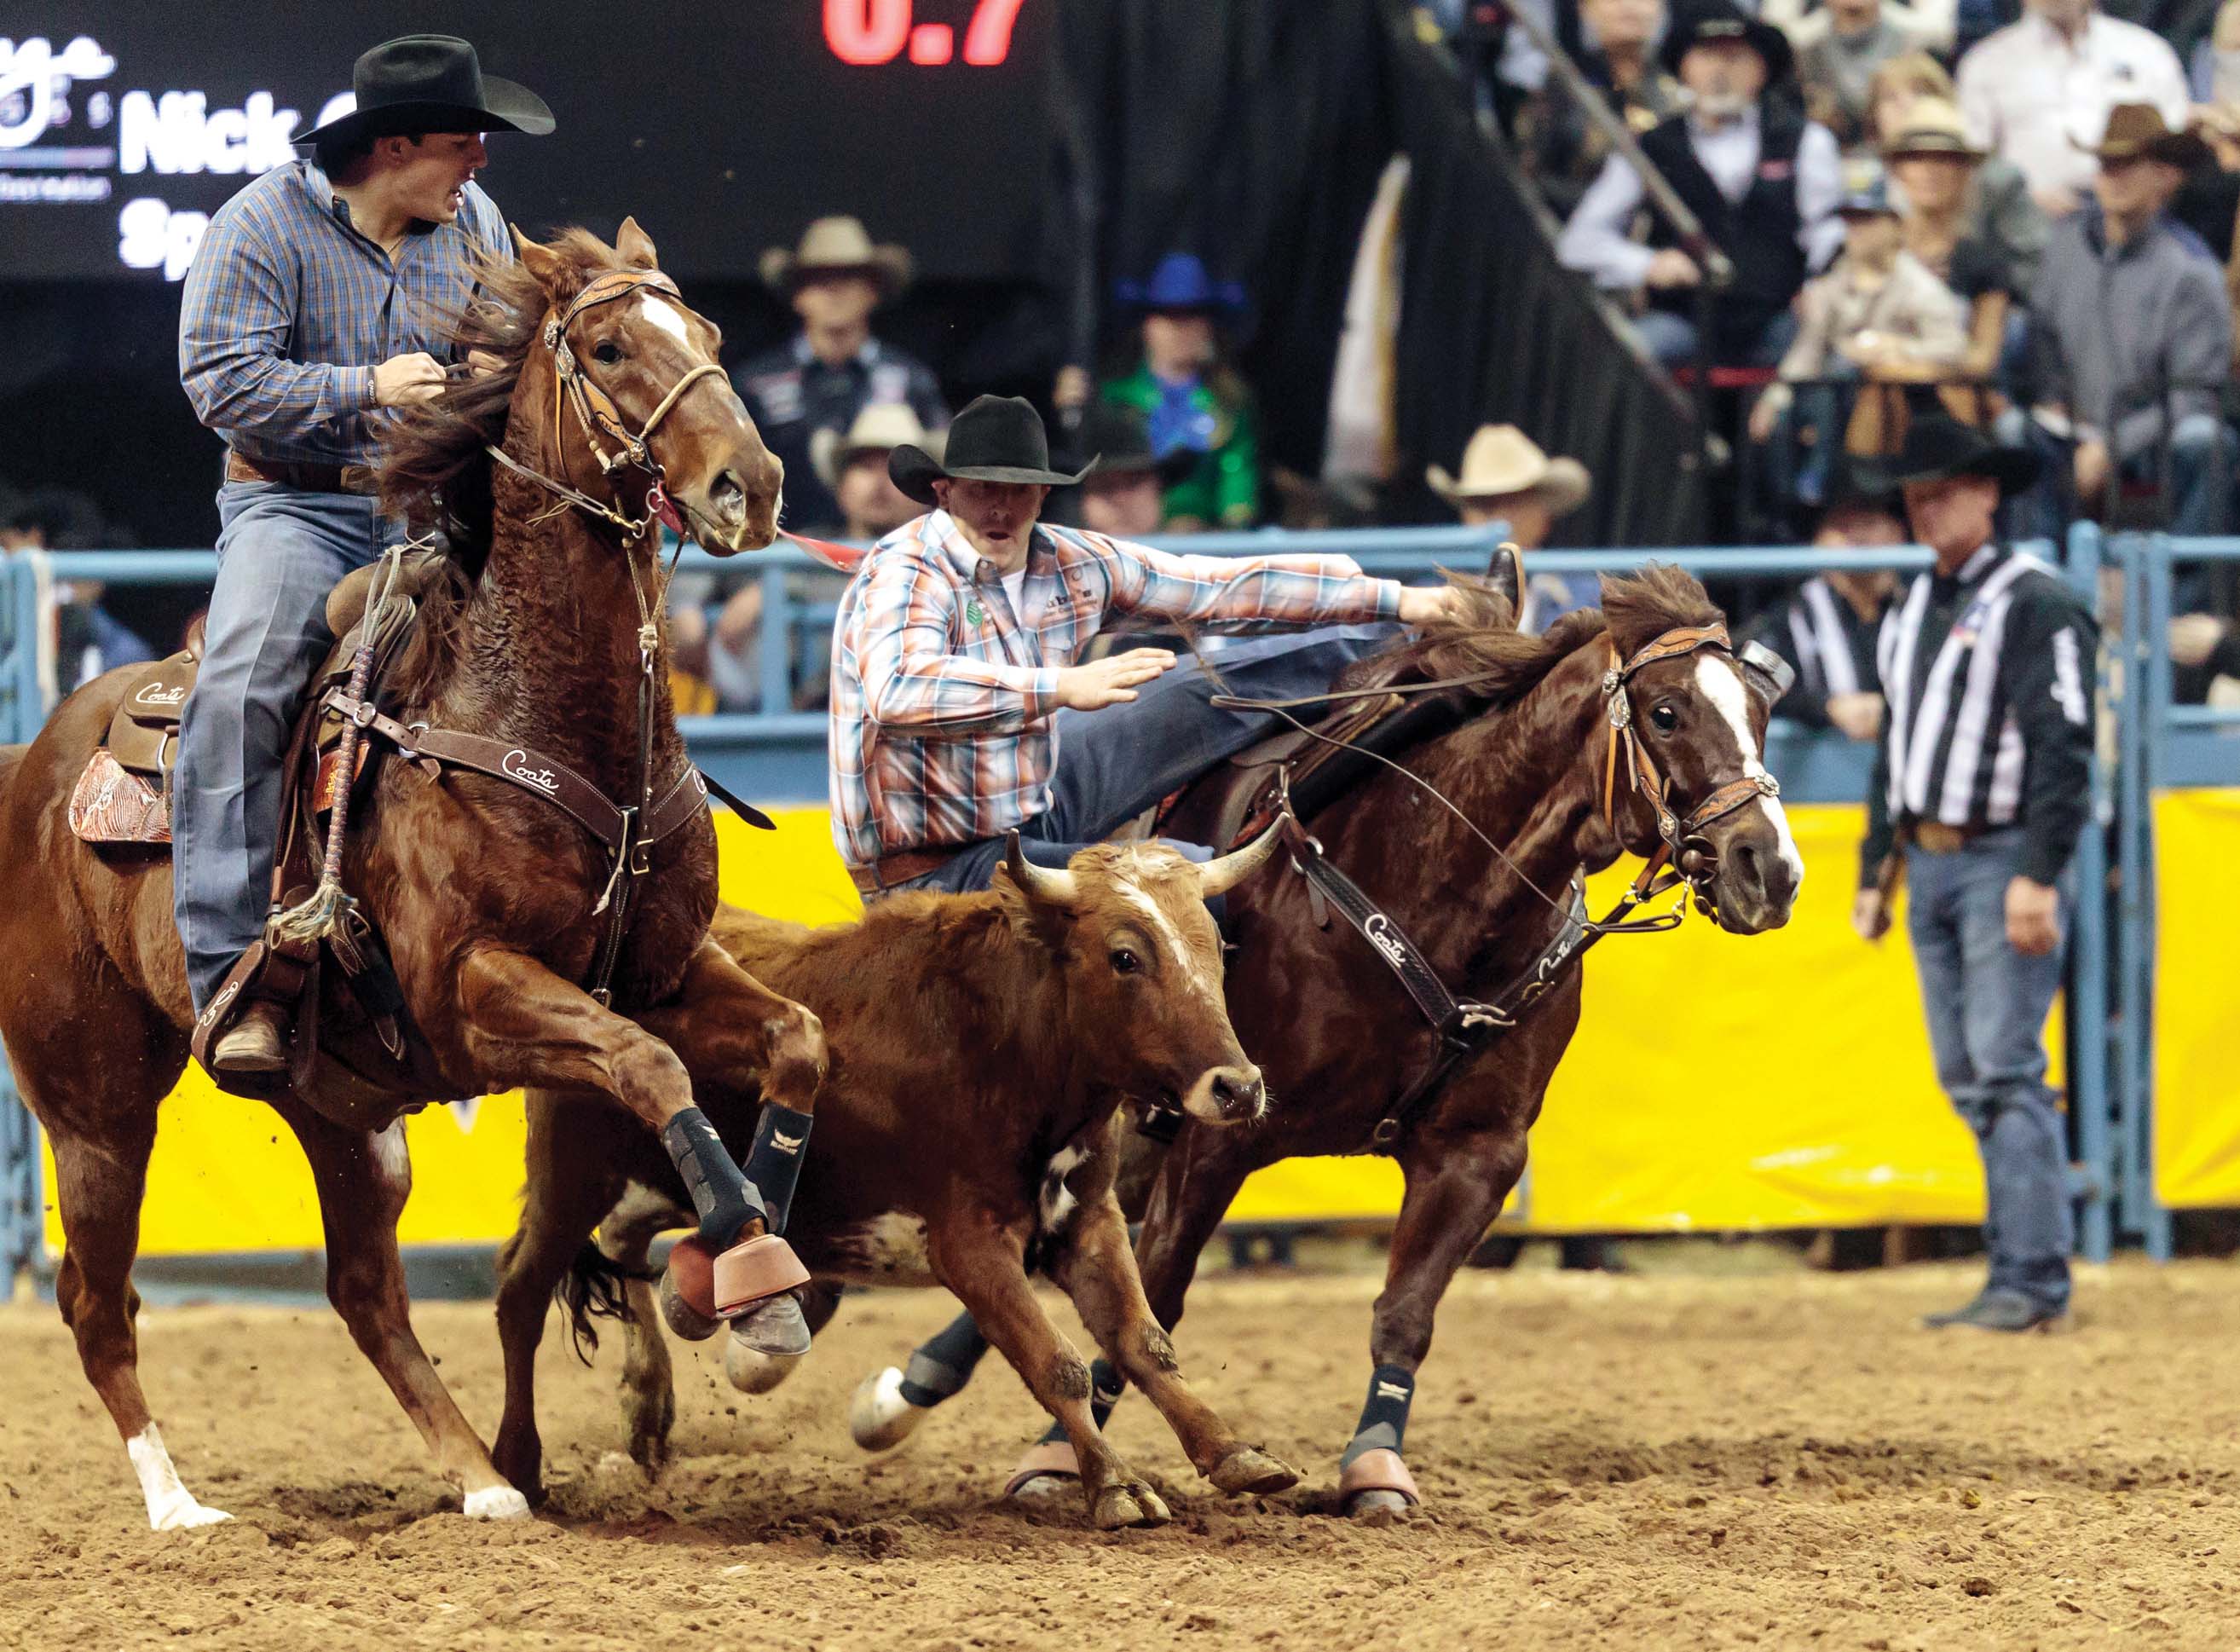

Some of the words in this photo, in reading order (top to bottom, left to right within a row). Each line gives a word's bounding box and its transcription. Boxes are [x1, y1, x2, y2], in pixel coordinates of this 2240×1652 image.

[120, 90, 302, 173] Nick
[119, 197, 211, 280] Sp
[136, 682, 185, 705] Coats
[502, 750, 560, 795] Coats
[1365, 914, 1406, 968] Coats
